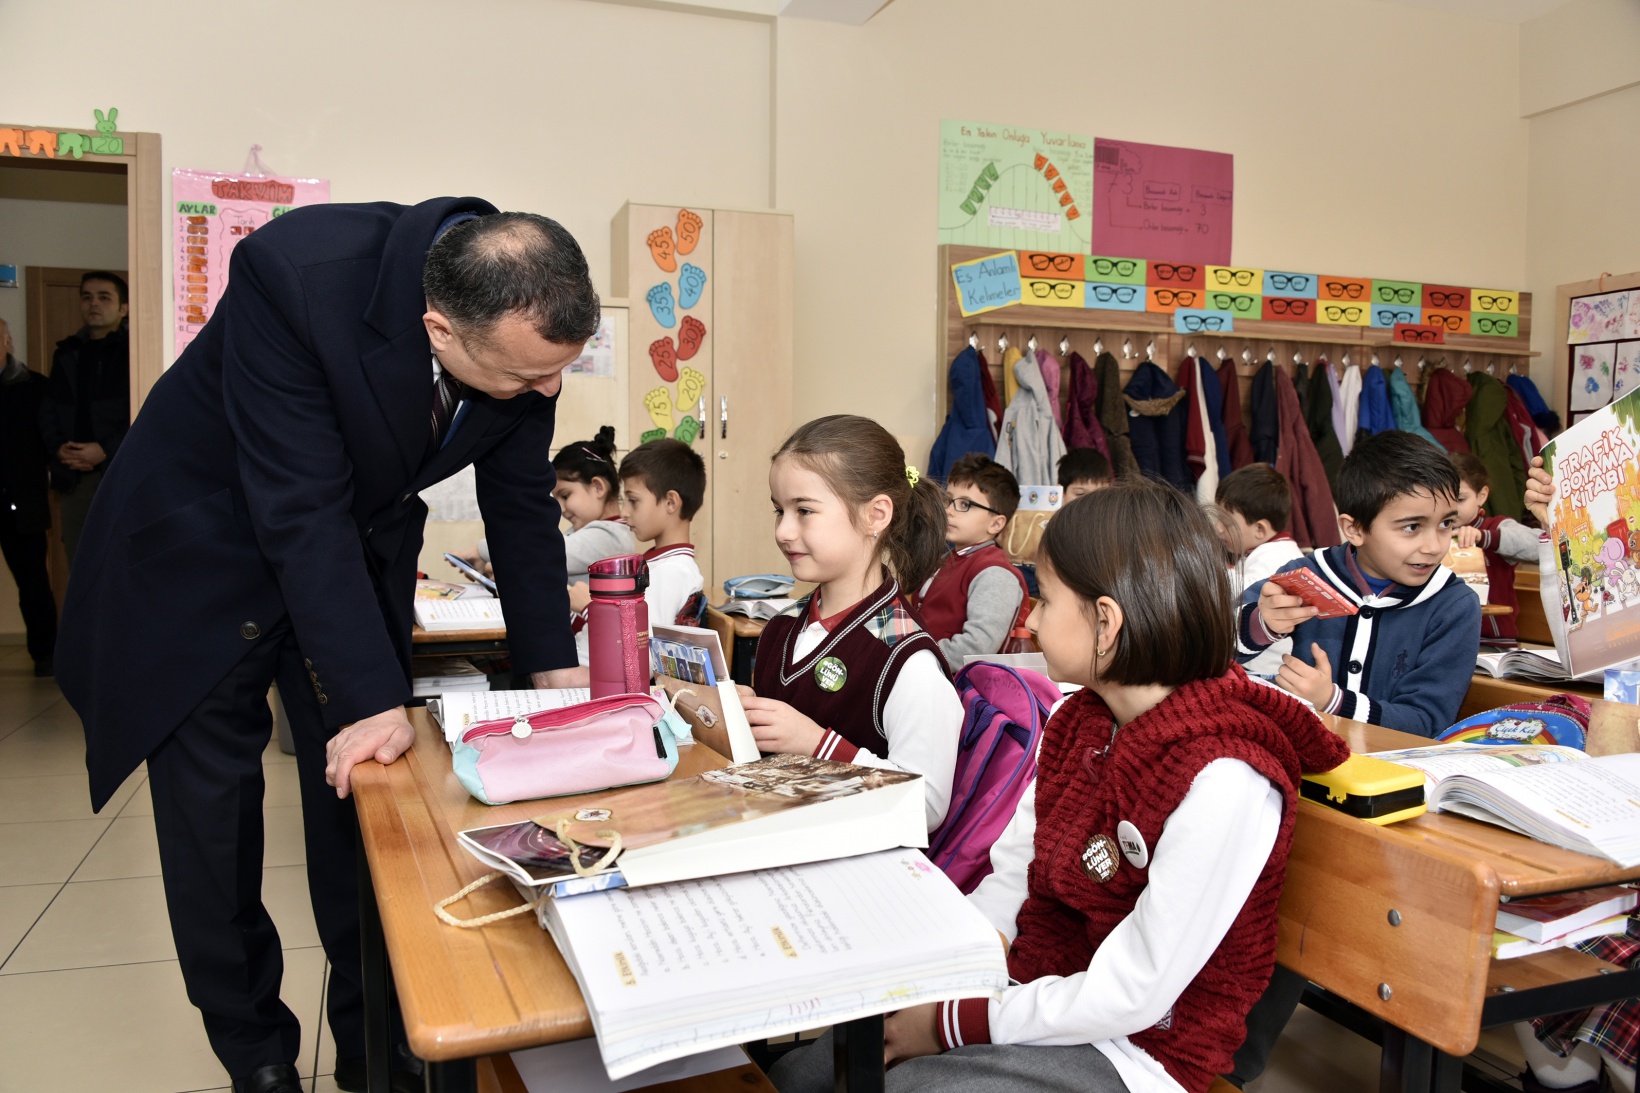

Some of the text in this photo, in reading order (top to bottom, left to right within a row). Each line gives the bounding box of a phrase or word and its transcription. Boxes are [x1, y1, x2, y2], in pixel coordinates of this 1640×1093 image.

[94, 139, 120, 153] 20
[214, 181, 294, 203] TAKVİM
[179, 204, 216, 214] AYLAR
[680, 221, 696, 244] 50
[654, 240, 670, 260] 45
[684, 275, 700, 298] 40
[655, 296, 671, 316] 35
[683, 328, 699, 349] 30
[658, 350, 674, 370] 25
[683, 378, 699, 402] 20
[653, 401, 669, 417] 15
[1559, 426, 1622, 479] TRAFİK
[1560, 443, 1634, 499] BOYAMA
[1570, 465, 1625, 512] KİTABI
[822, 676, 835, 688] VER
[1086, 848, 1108, 870] LÜNÜ
[1094, 858, 1112, 874] VER
